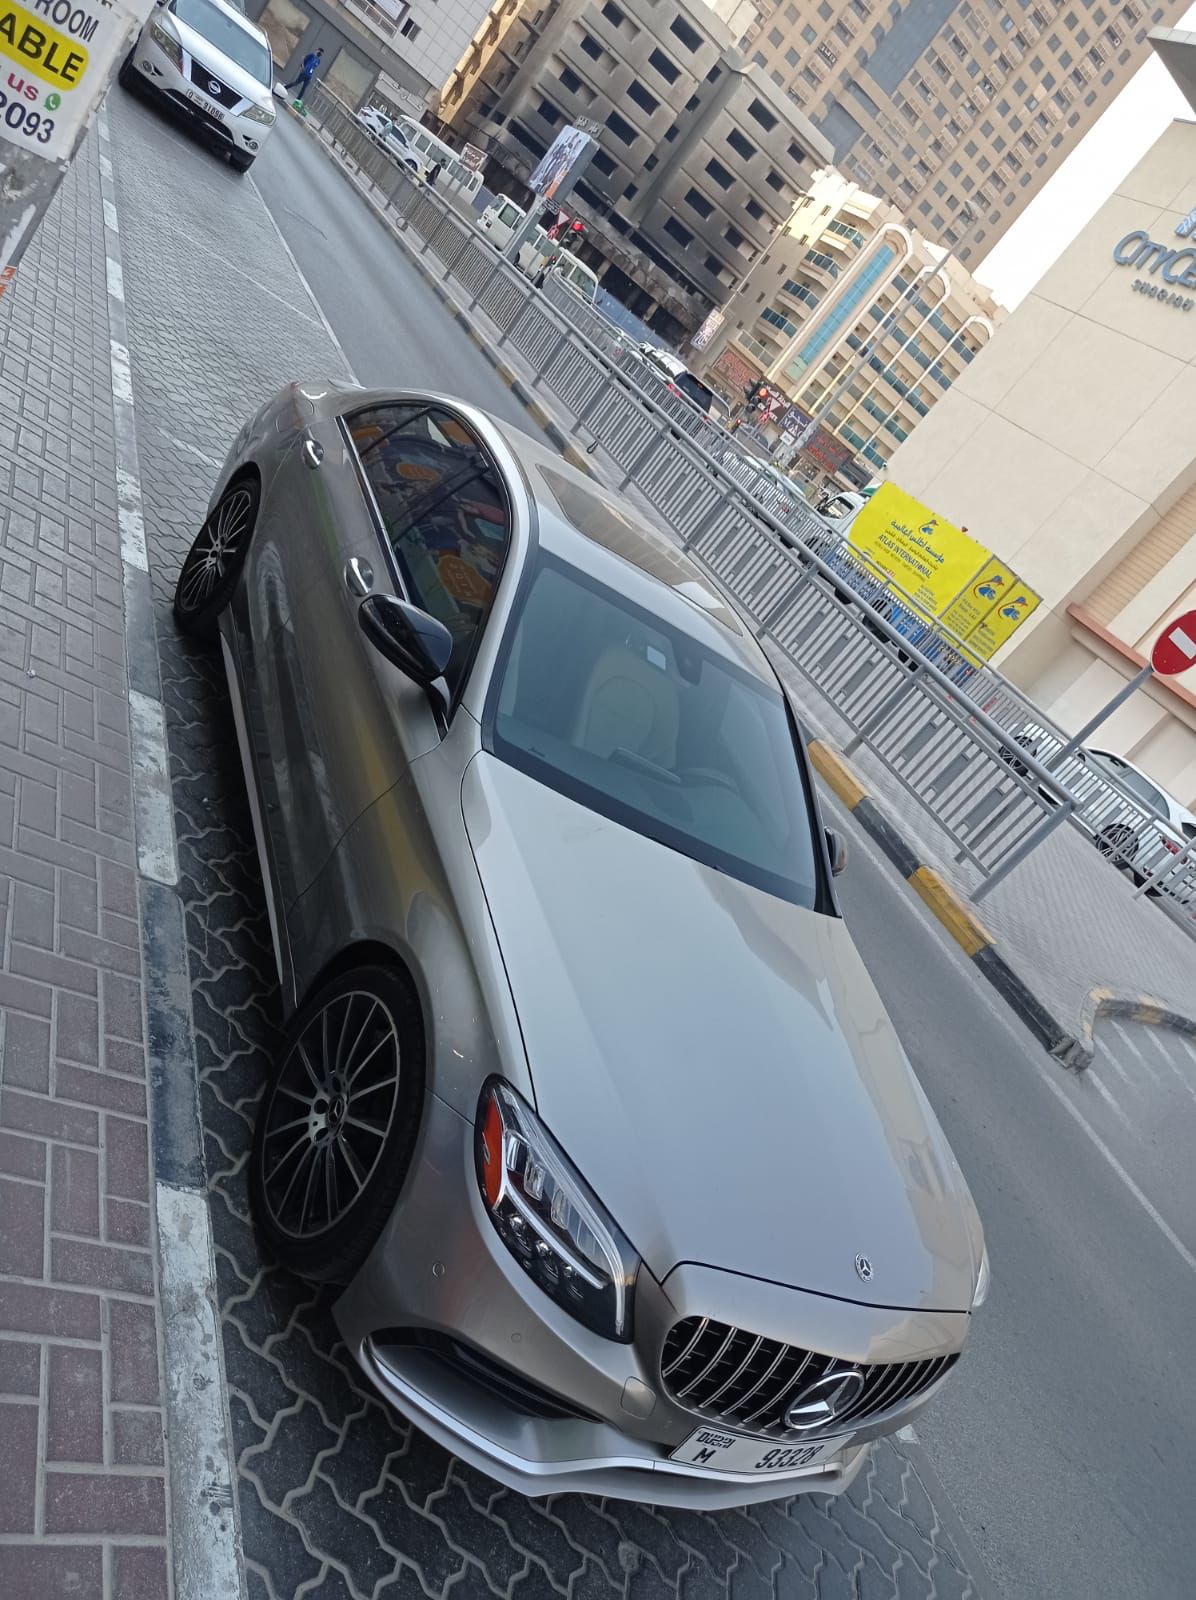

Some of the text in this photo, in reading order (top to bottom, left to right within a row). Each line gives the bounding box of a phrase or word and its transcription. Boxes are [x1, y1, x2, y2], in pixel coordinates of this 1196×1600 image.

[7, 72, 39, 101] us
[878, 534, 896, 550] ATLAS
[893, 544, 932, 579] INTERNATIONAL
[692, 1444, 825, 1469] M 93328
